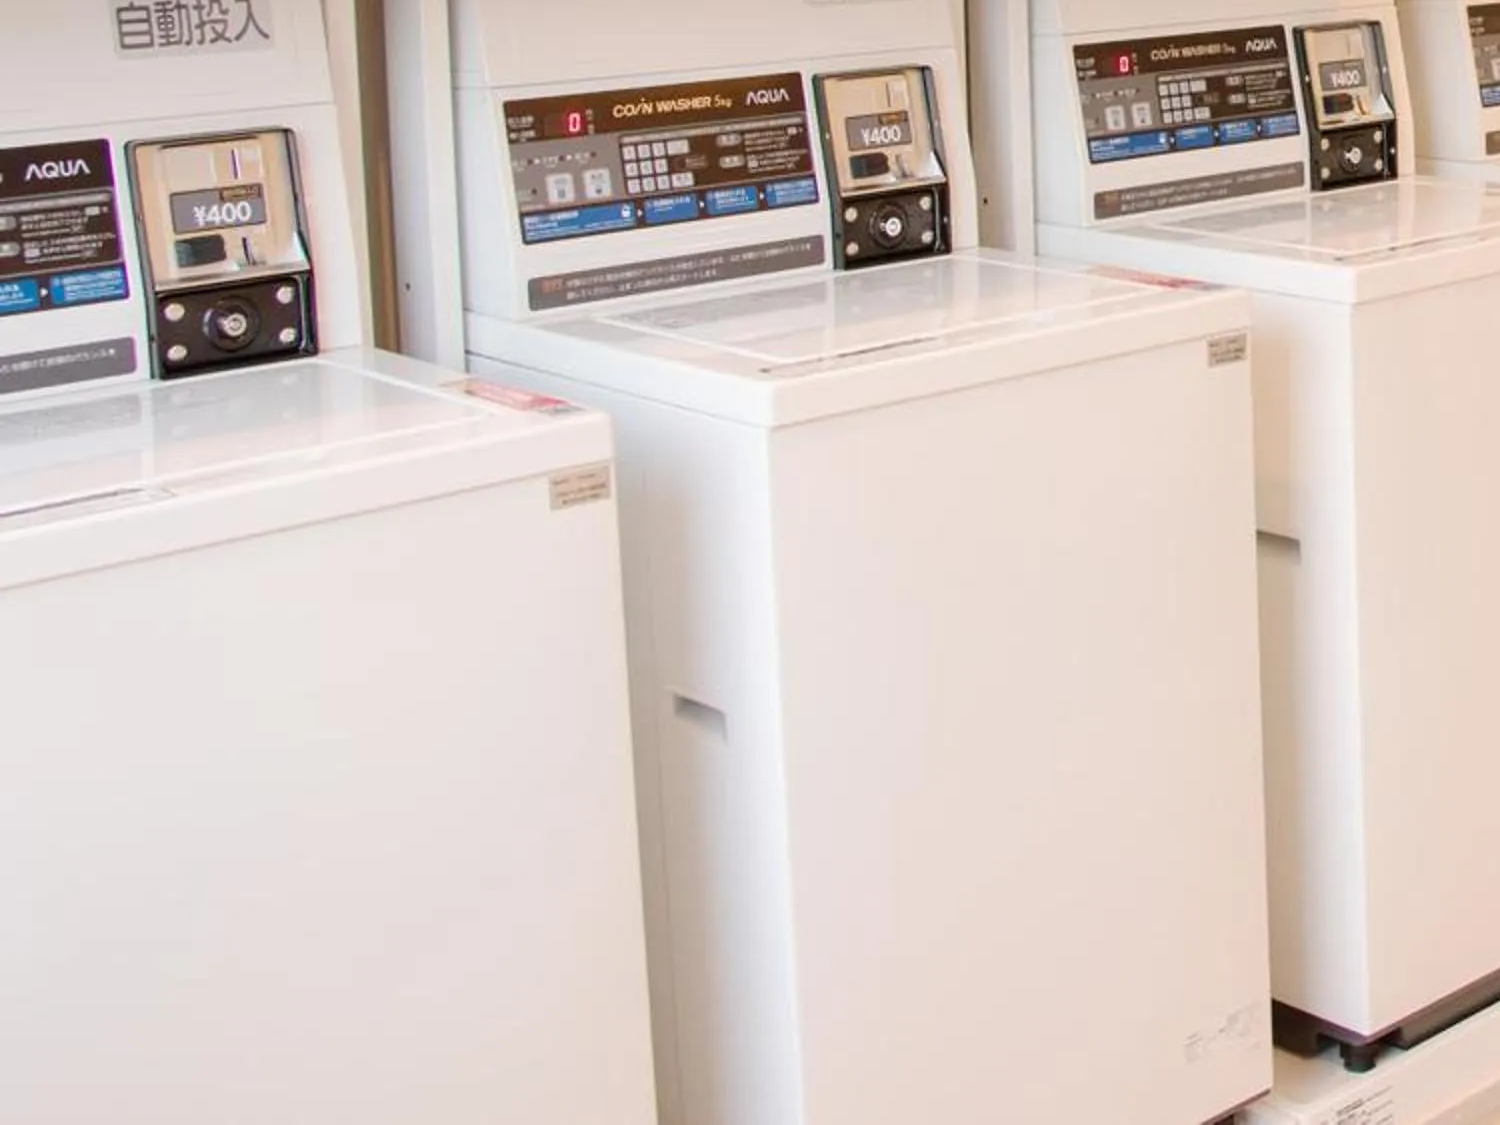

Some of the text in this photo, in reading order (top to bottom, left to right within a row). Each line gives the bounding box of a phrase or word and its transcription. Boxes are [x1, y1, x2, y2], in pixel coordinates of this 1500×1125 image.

[1119, 56, 1129, 72] 0
[655, 96, 712, 114] WASHER
[745, 88, 790, 106] AQUA
[569, 112, 581, 133] 0
[861, 125, 901, 146] ¥400
[25, 158, 91, 181] AQUA
[193, 201, 252, 226] ¥400
